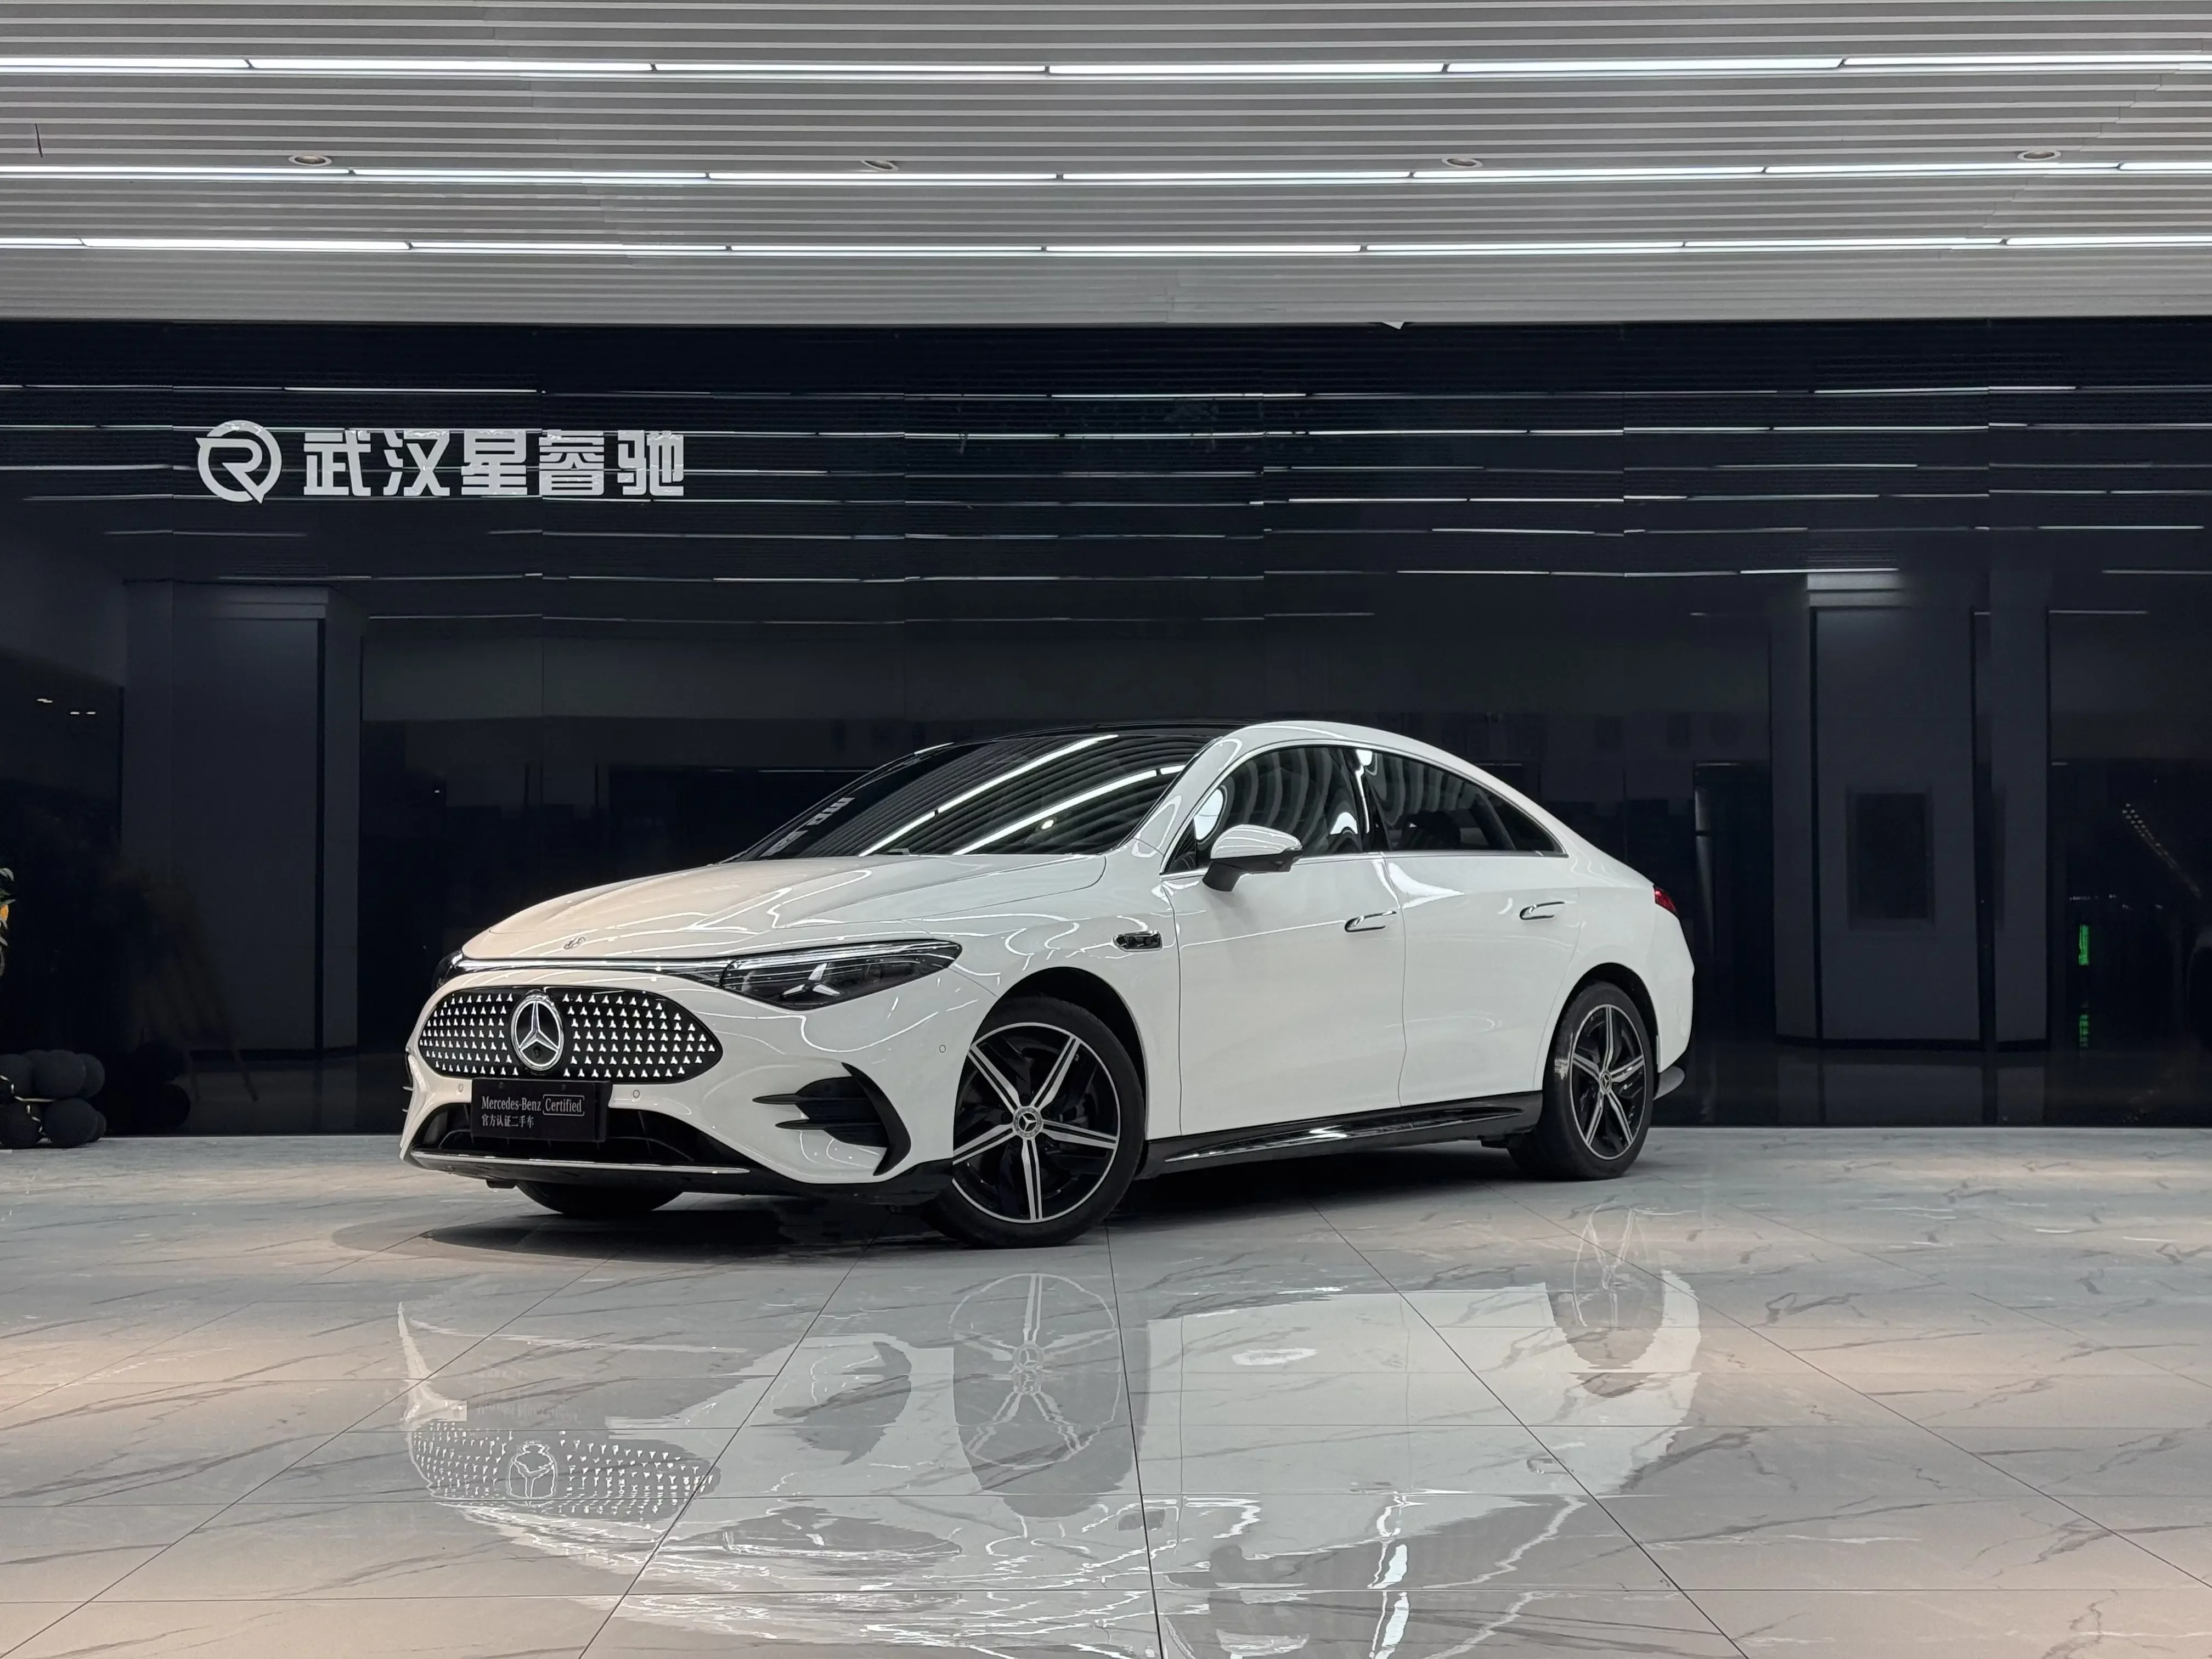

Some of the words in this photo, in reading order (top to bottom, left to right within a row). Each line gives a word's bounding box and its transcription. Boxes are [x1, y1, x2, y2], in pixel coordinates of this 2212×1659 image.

[303, 430, 684, 496] 武汉星睿驰
[481, 1096, 541, 1111] Mercedes-Benz
[545, 1098, 582, 1113] Certified
[481, 1113, 534, 1129] 官方认证二手车
